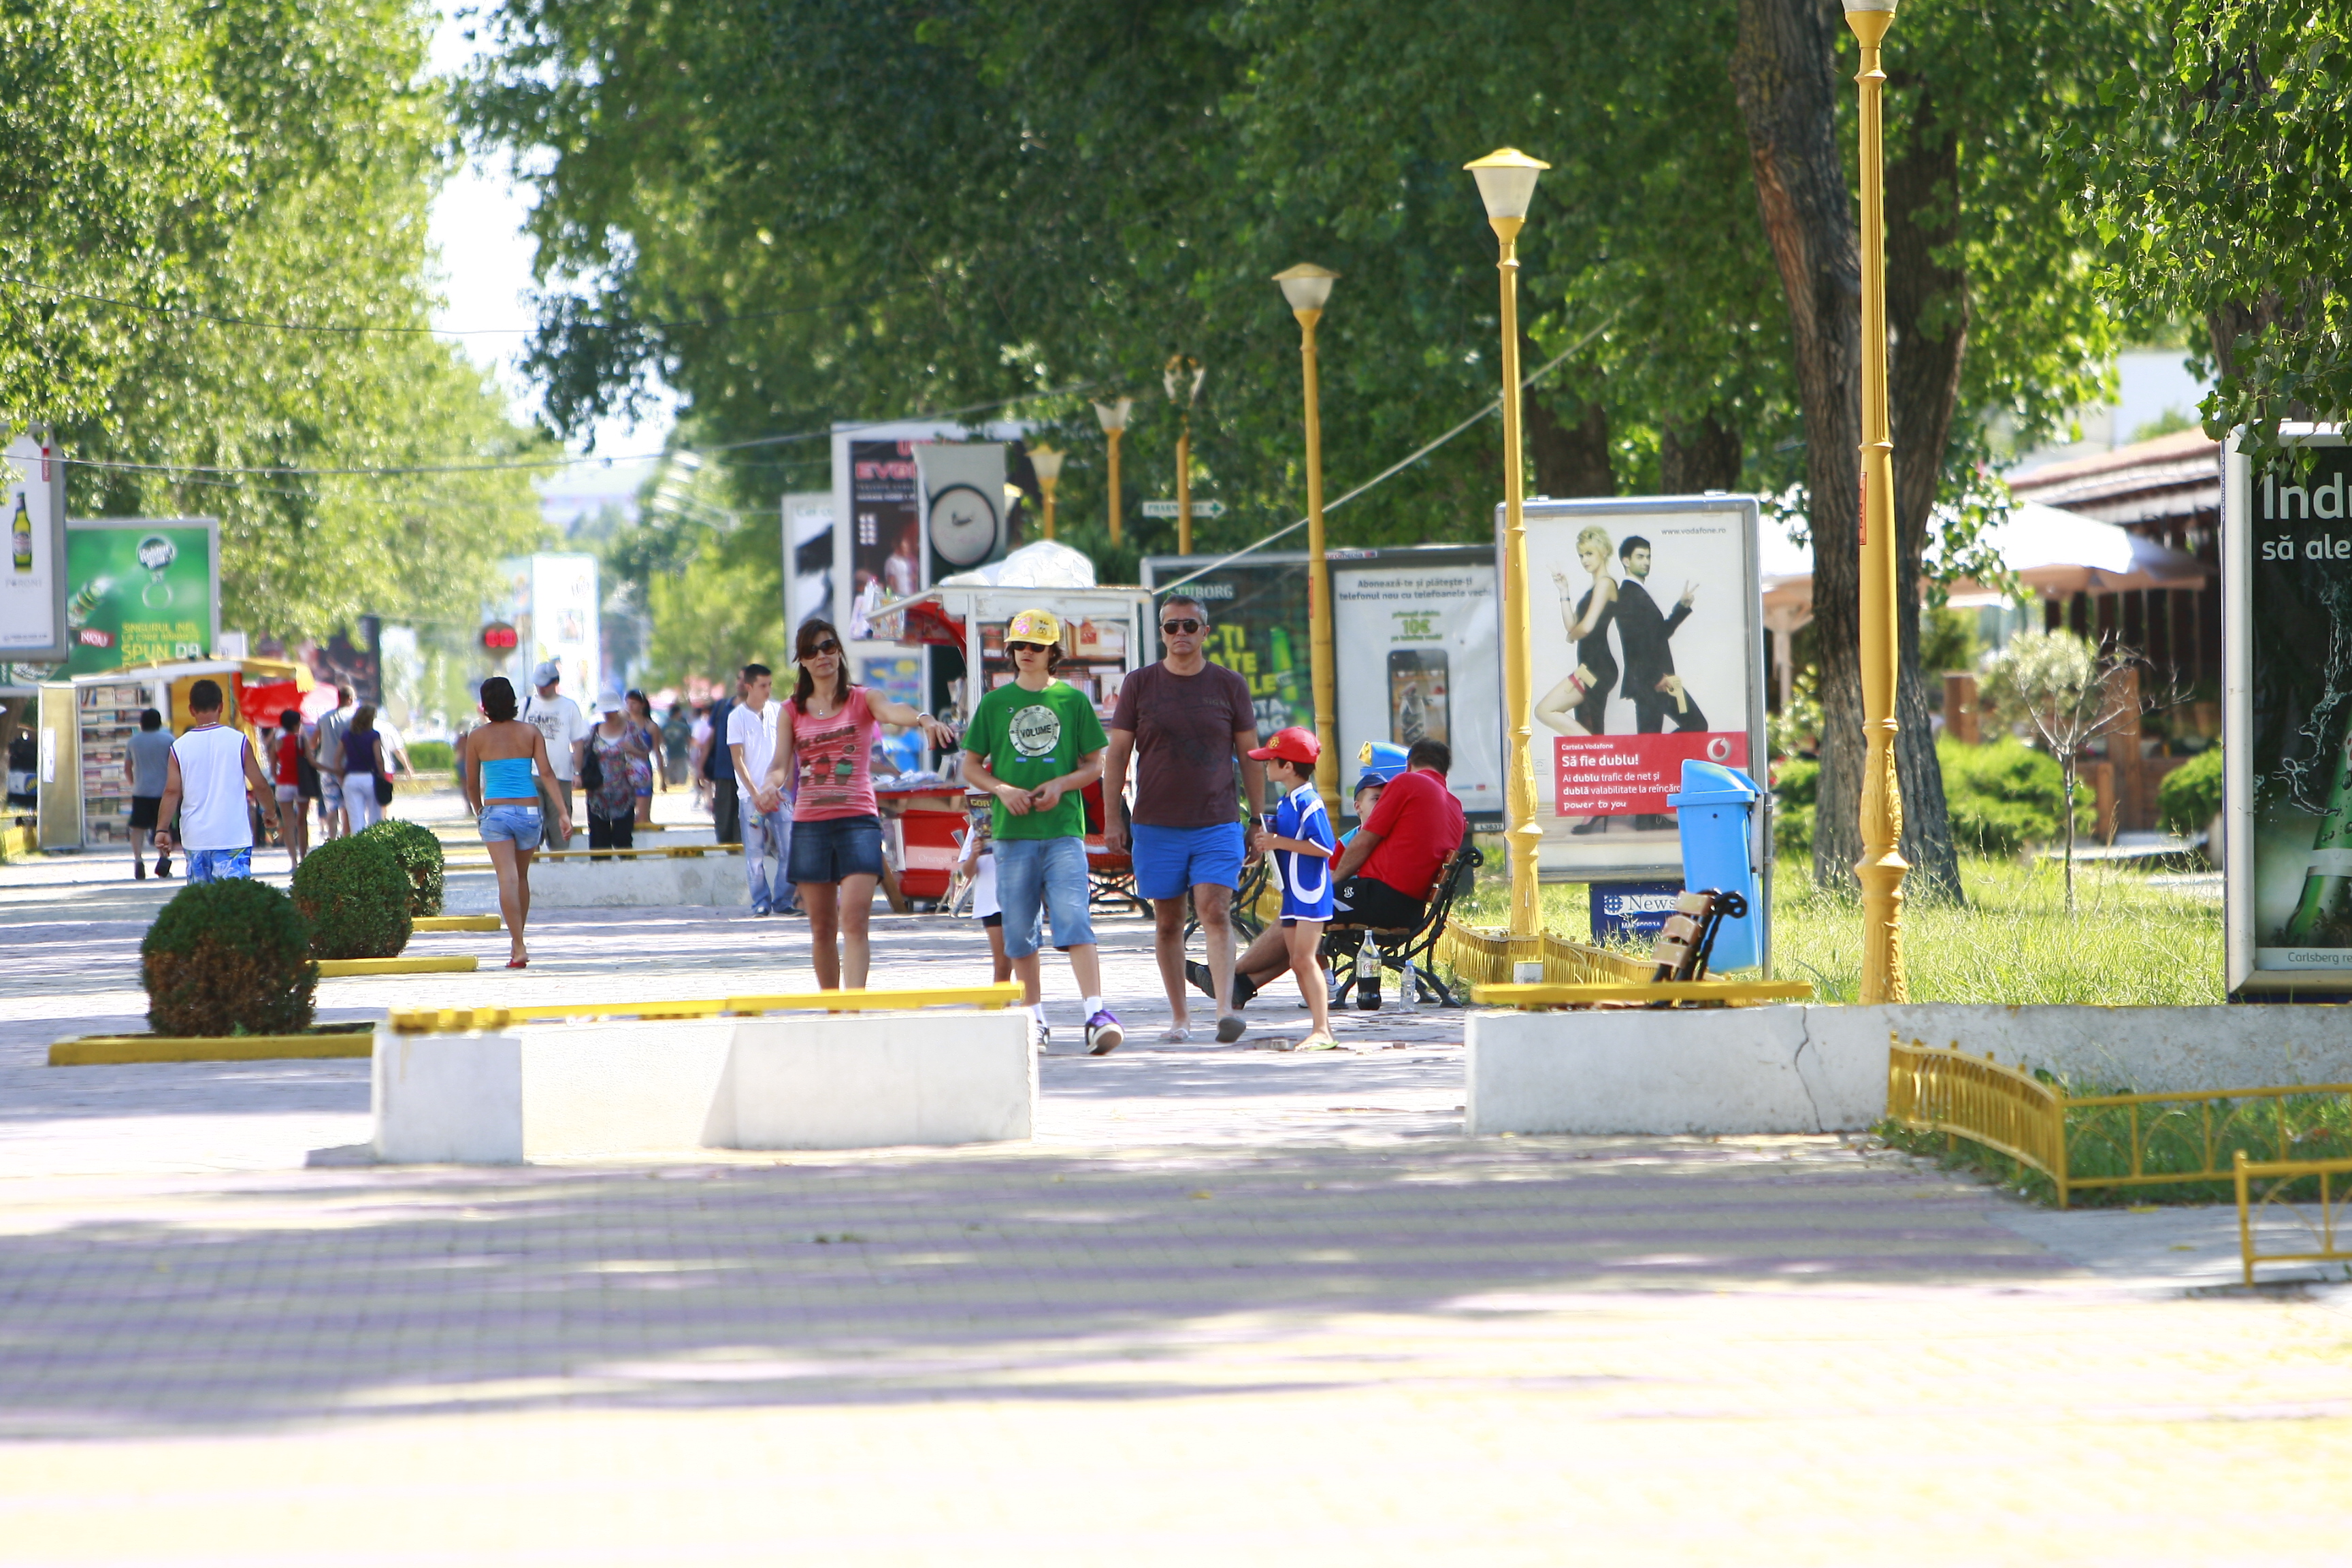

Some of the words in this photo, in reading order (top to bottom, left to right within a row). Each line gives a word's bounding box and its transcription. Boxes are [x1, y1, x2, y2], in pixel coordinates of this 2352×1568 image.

[1661, 527, 1726, 535] www.vodafone.ro
[2262, 534, 2294, 560] să
[2305, 533, 2351, 560] ale
[1357, 578, 1414, 589] Abonează-te
[1175, 584, 1234, 600] TUBORG
[1339, 591, 1379, 601] telefonul
[1382, 592, 1399, 600] nou
[1414, 589, 1465, 600] telefoanele
[1402, 618, 1431, 635] 10€
[121, 643, 169, 661] SPUN
[1208, 651, 1258, 673] ATE
[1020, 724, 1052, 738] VOLUME
[1561, 755, 1578, 767] Să
[1579, 755, 1597, 767] fie
[1598, 753, 1639, 766] dublu!
[1563, 774, 1571, 783] Ai
[1572, 773, 1599, 782] dublu
[1601, 772, 1623, 781] trafic
[1624, 772, 1635, 781] de
[1637, 772, 1652, 781] net
[1563, 786, 1590, 796] dublă
[1590, 785, 1637, 795] valabilitate
[1638, 785, 1647, 794] la
[1648, 783, 1681, 794] reîncărc
[1563, 801, 1595, 811] power
[1597, 800, 1608, 809] to
[1610, 800, 1627, 811] you
[918, 855, 949, 864] Orange
[1629, 895, 1676, 911] News
[2287, 951, 2339, 966] Carlsberg
